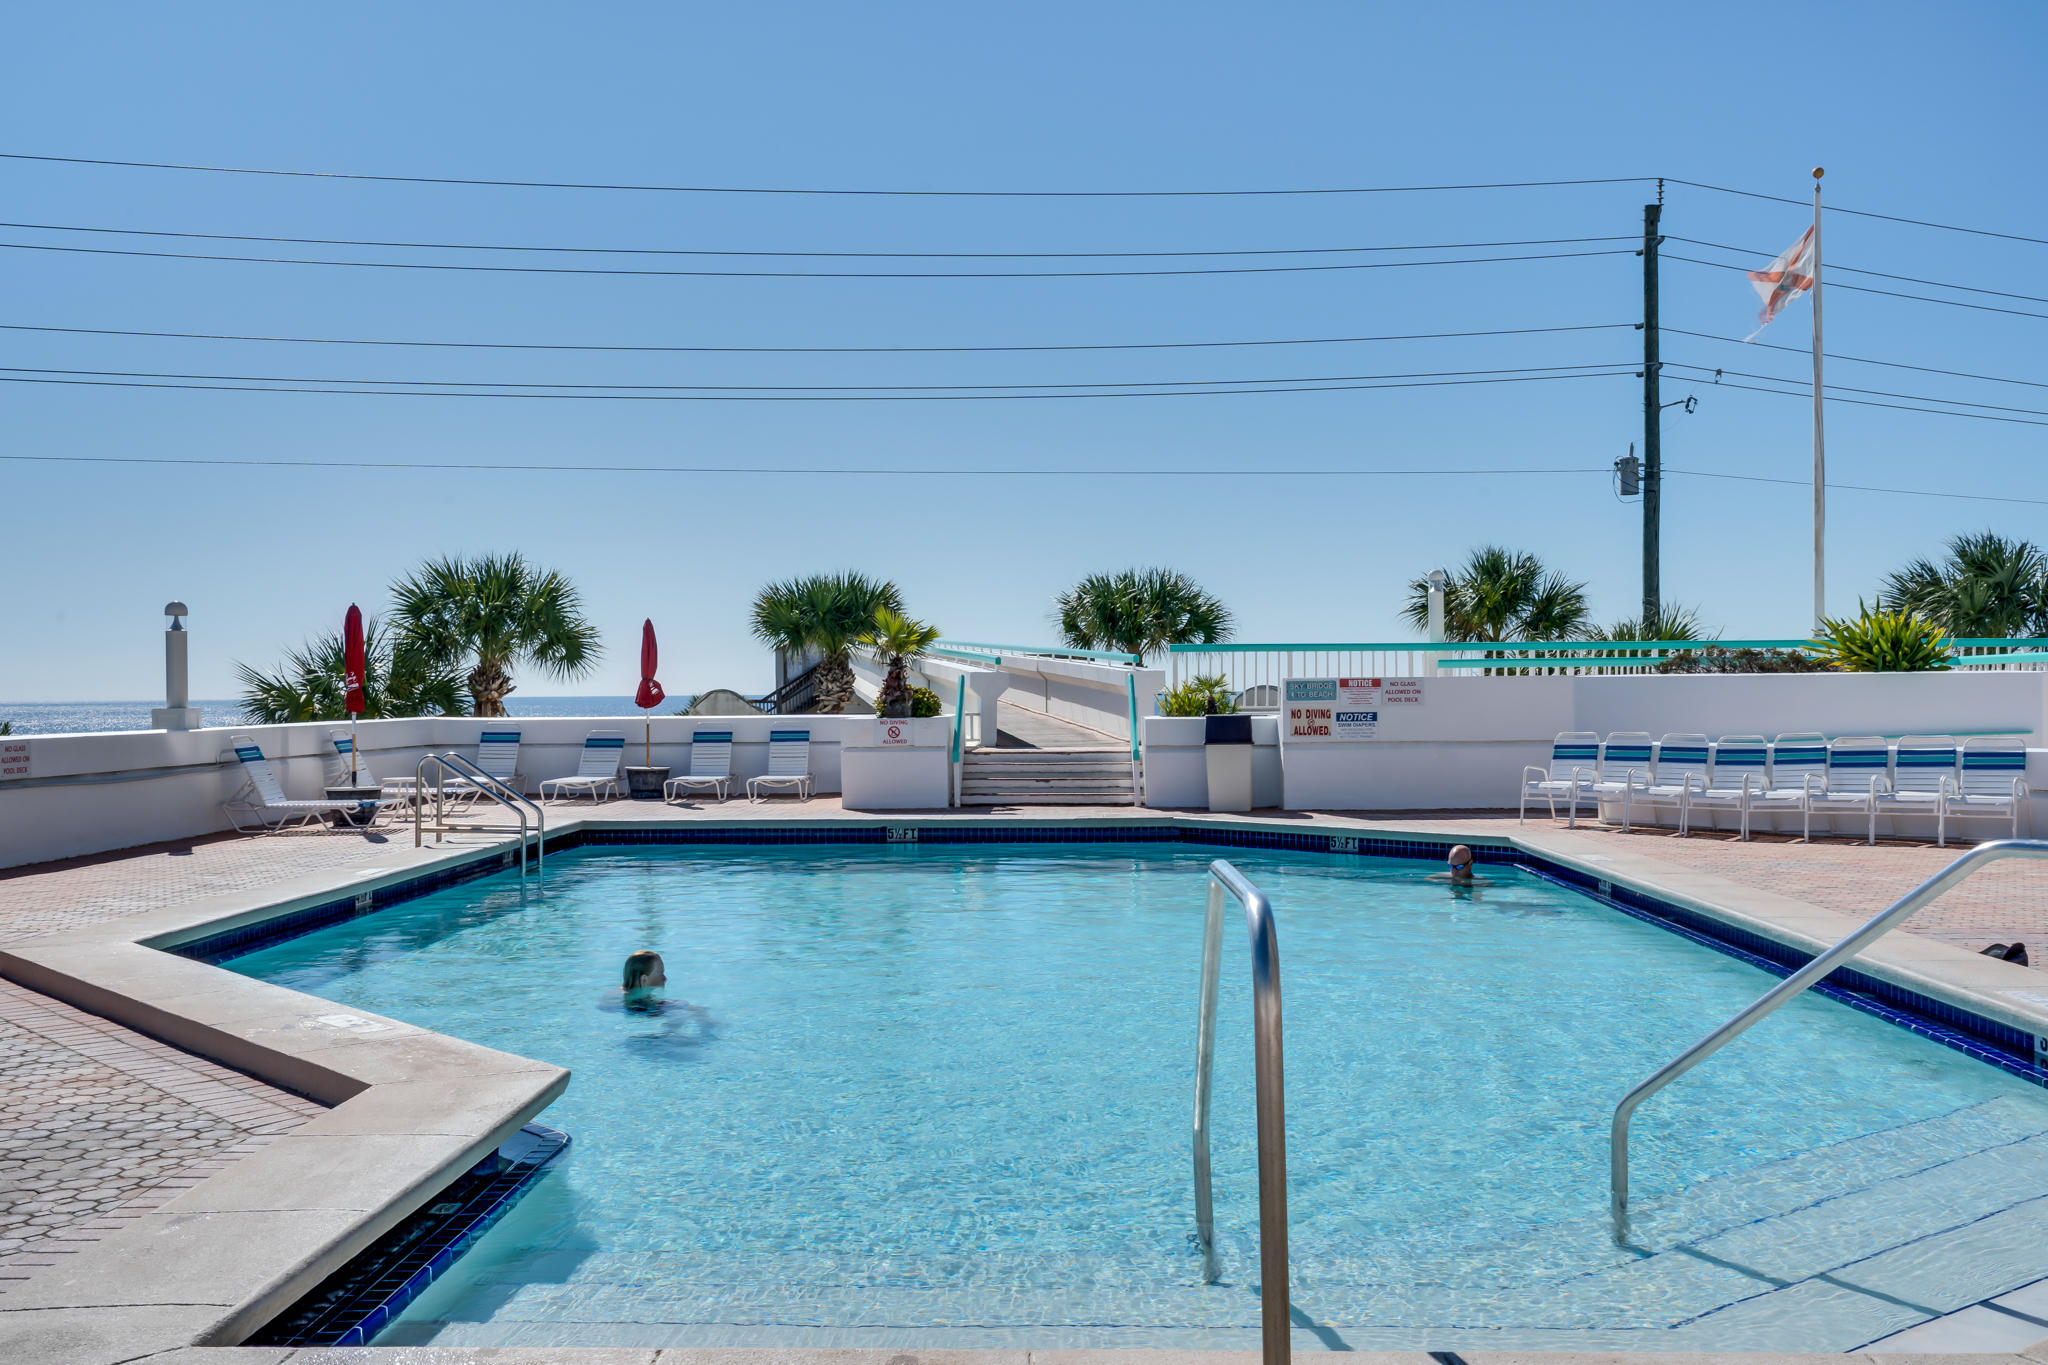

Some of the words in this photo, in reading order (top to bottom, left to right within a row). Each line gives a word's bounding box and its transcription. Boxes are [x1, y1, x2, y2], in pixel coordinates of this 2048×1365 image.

[1348, 679, 1373, 687] NOTICE
[1291, 709, 1302, 719] NO
[1305, 709, 1331, 719] DIVING
[1339, 713, 1373, 721] NOTICE
[1294, 725, 1329, 736] ALLOWED
